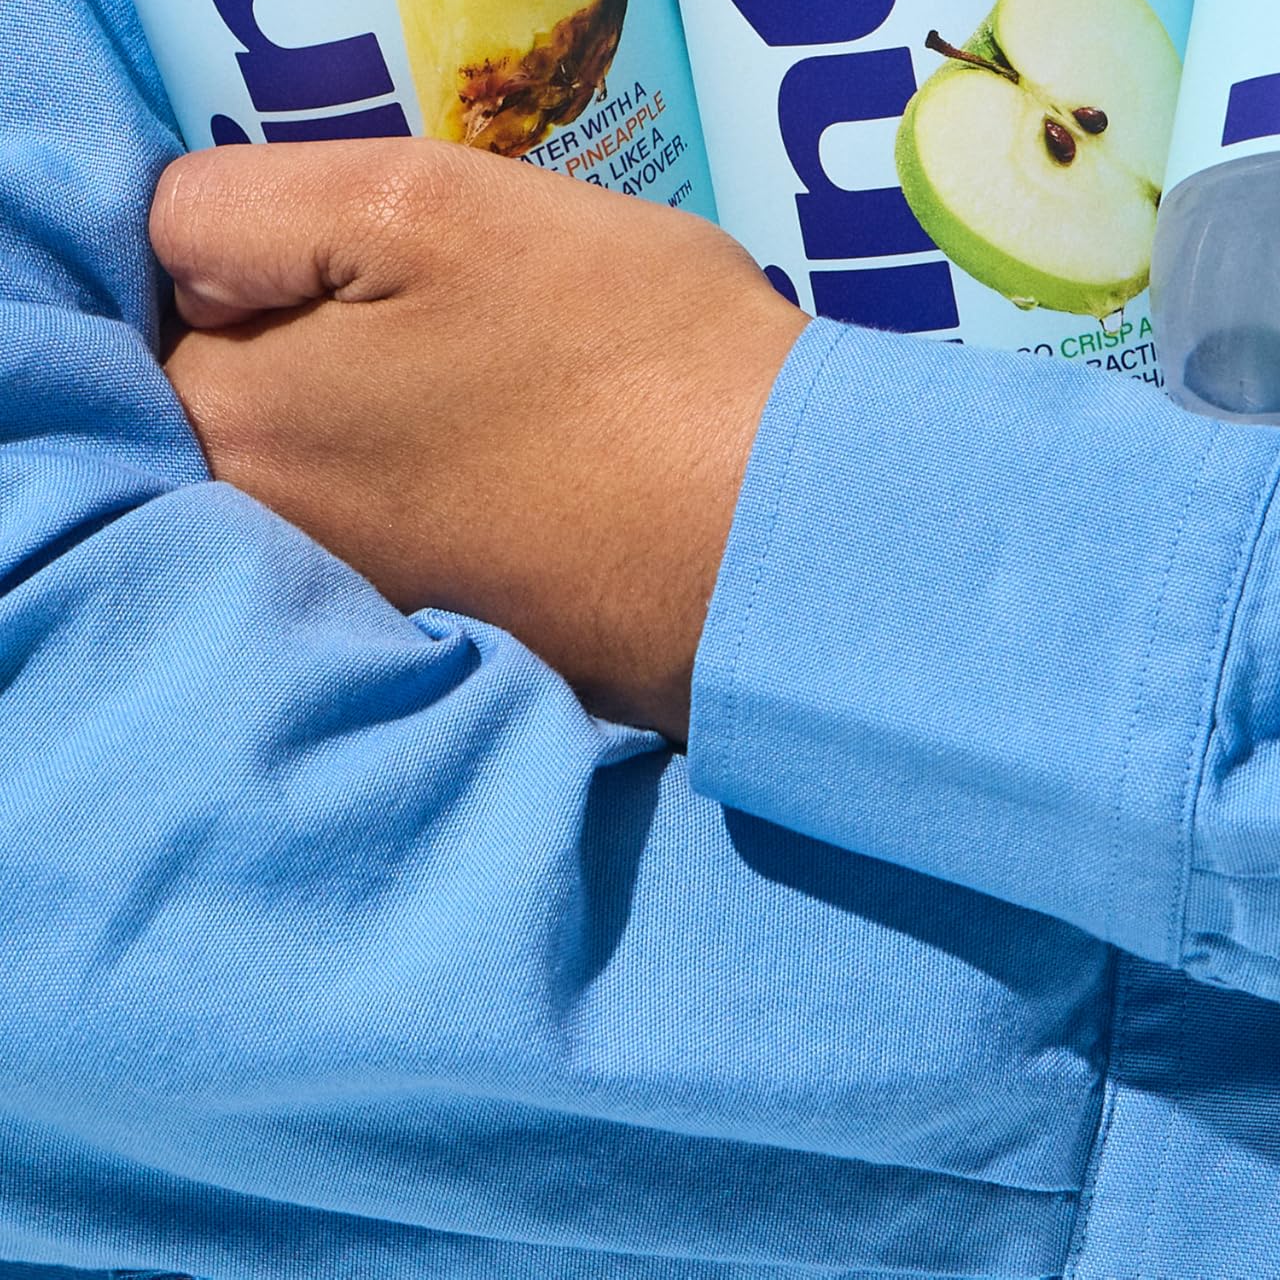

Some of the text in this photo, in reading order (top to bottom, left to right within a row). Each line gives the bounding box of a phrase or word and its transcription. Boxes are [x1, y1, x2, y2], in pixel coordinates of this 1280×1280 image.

[565, 90, 667, 177] PINEAPPLE
[580, 92, 633, 140] WITH
[635, 81, 647, 104] A
[609, 127, 665, 181] LIKE A
[668, 180, 693, 208] WITH
[1060, 323, 1133, 358] CRISP
